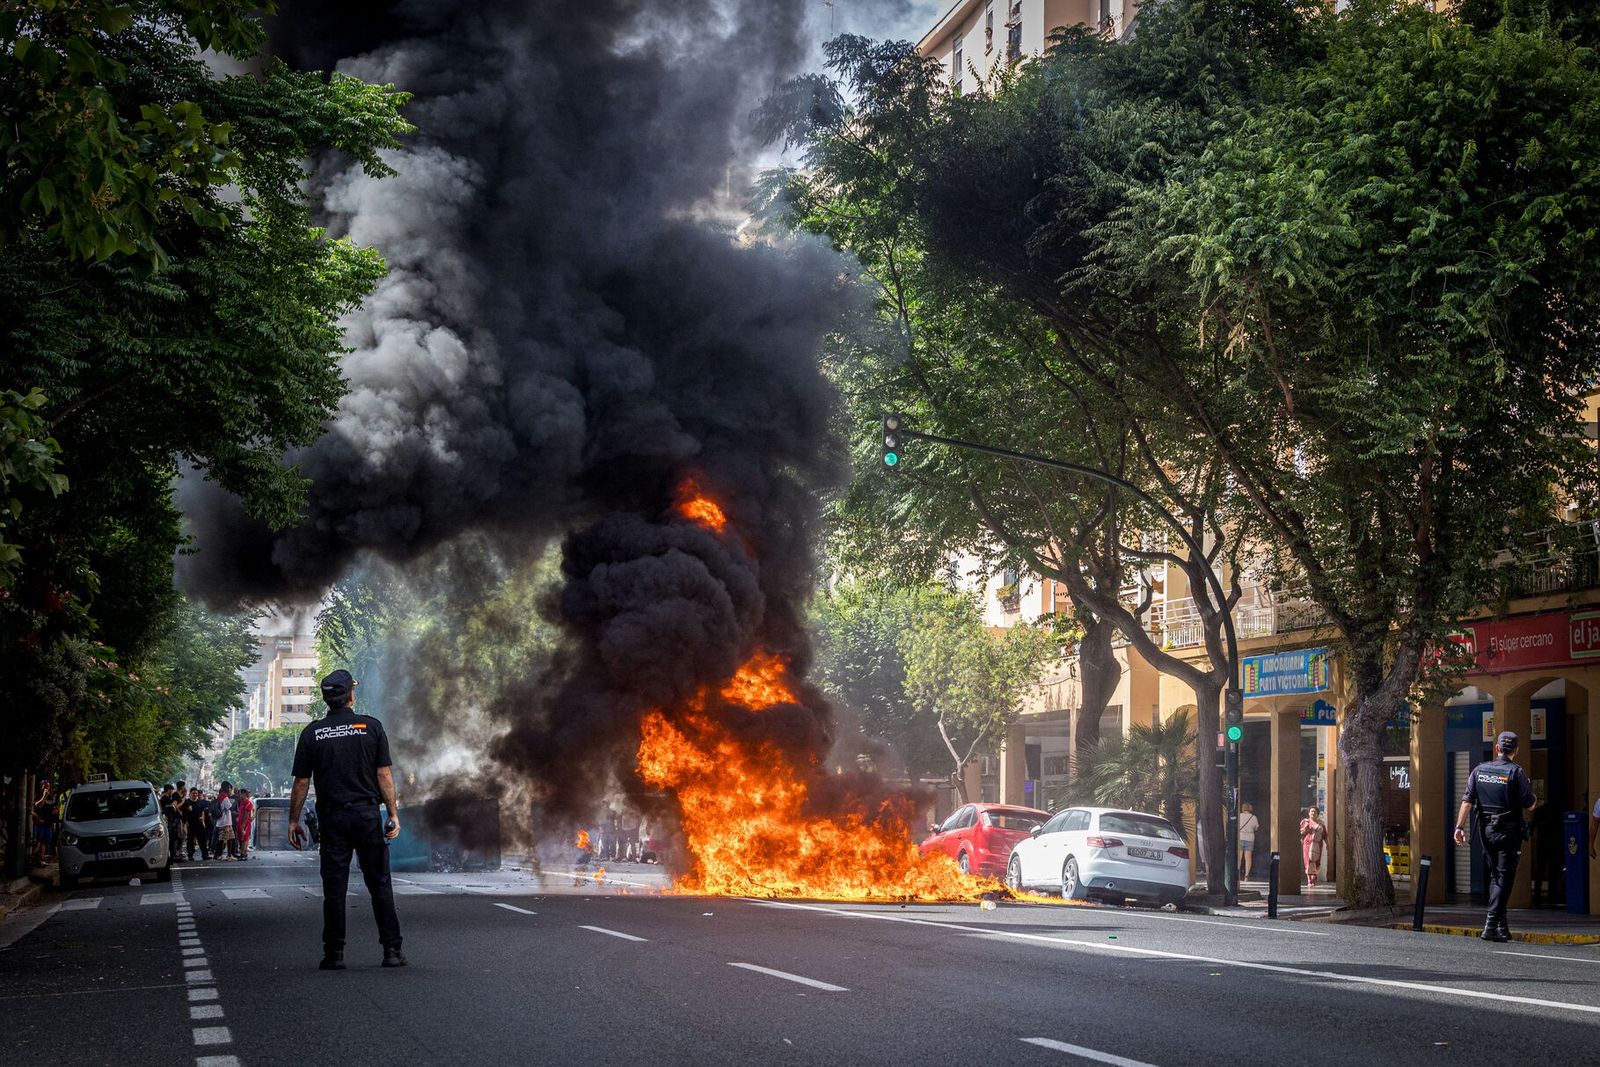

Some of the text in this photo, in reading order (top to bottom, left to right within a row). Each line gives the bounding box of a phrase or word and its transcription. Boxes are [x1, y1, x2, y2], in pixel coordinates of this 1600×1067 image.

[1574, 620, 1585, 645] el
[1490, 637, 1499, 651] El
[1499, 635, 1520, 653] súper
[1520, 632, 1553, 648] cercano
[1277, 673, 1308, 690] VICTORIA
[315, 724, 354, 735] POLICIA
[316, 729, 367, 741] NACIONAL
